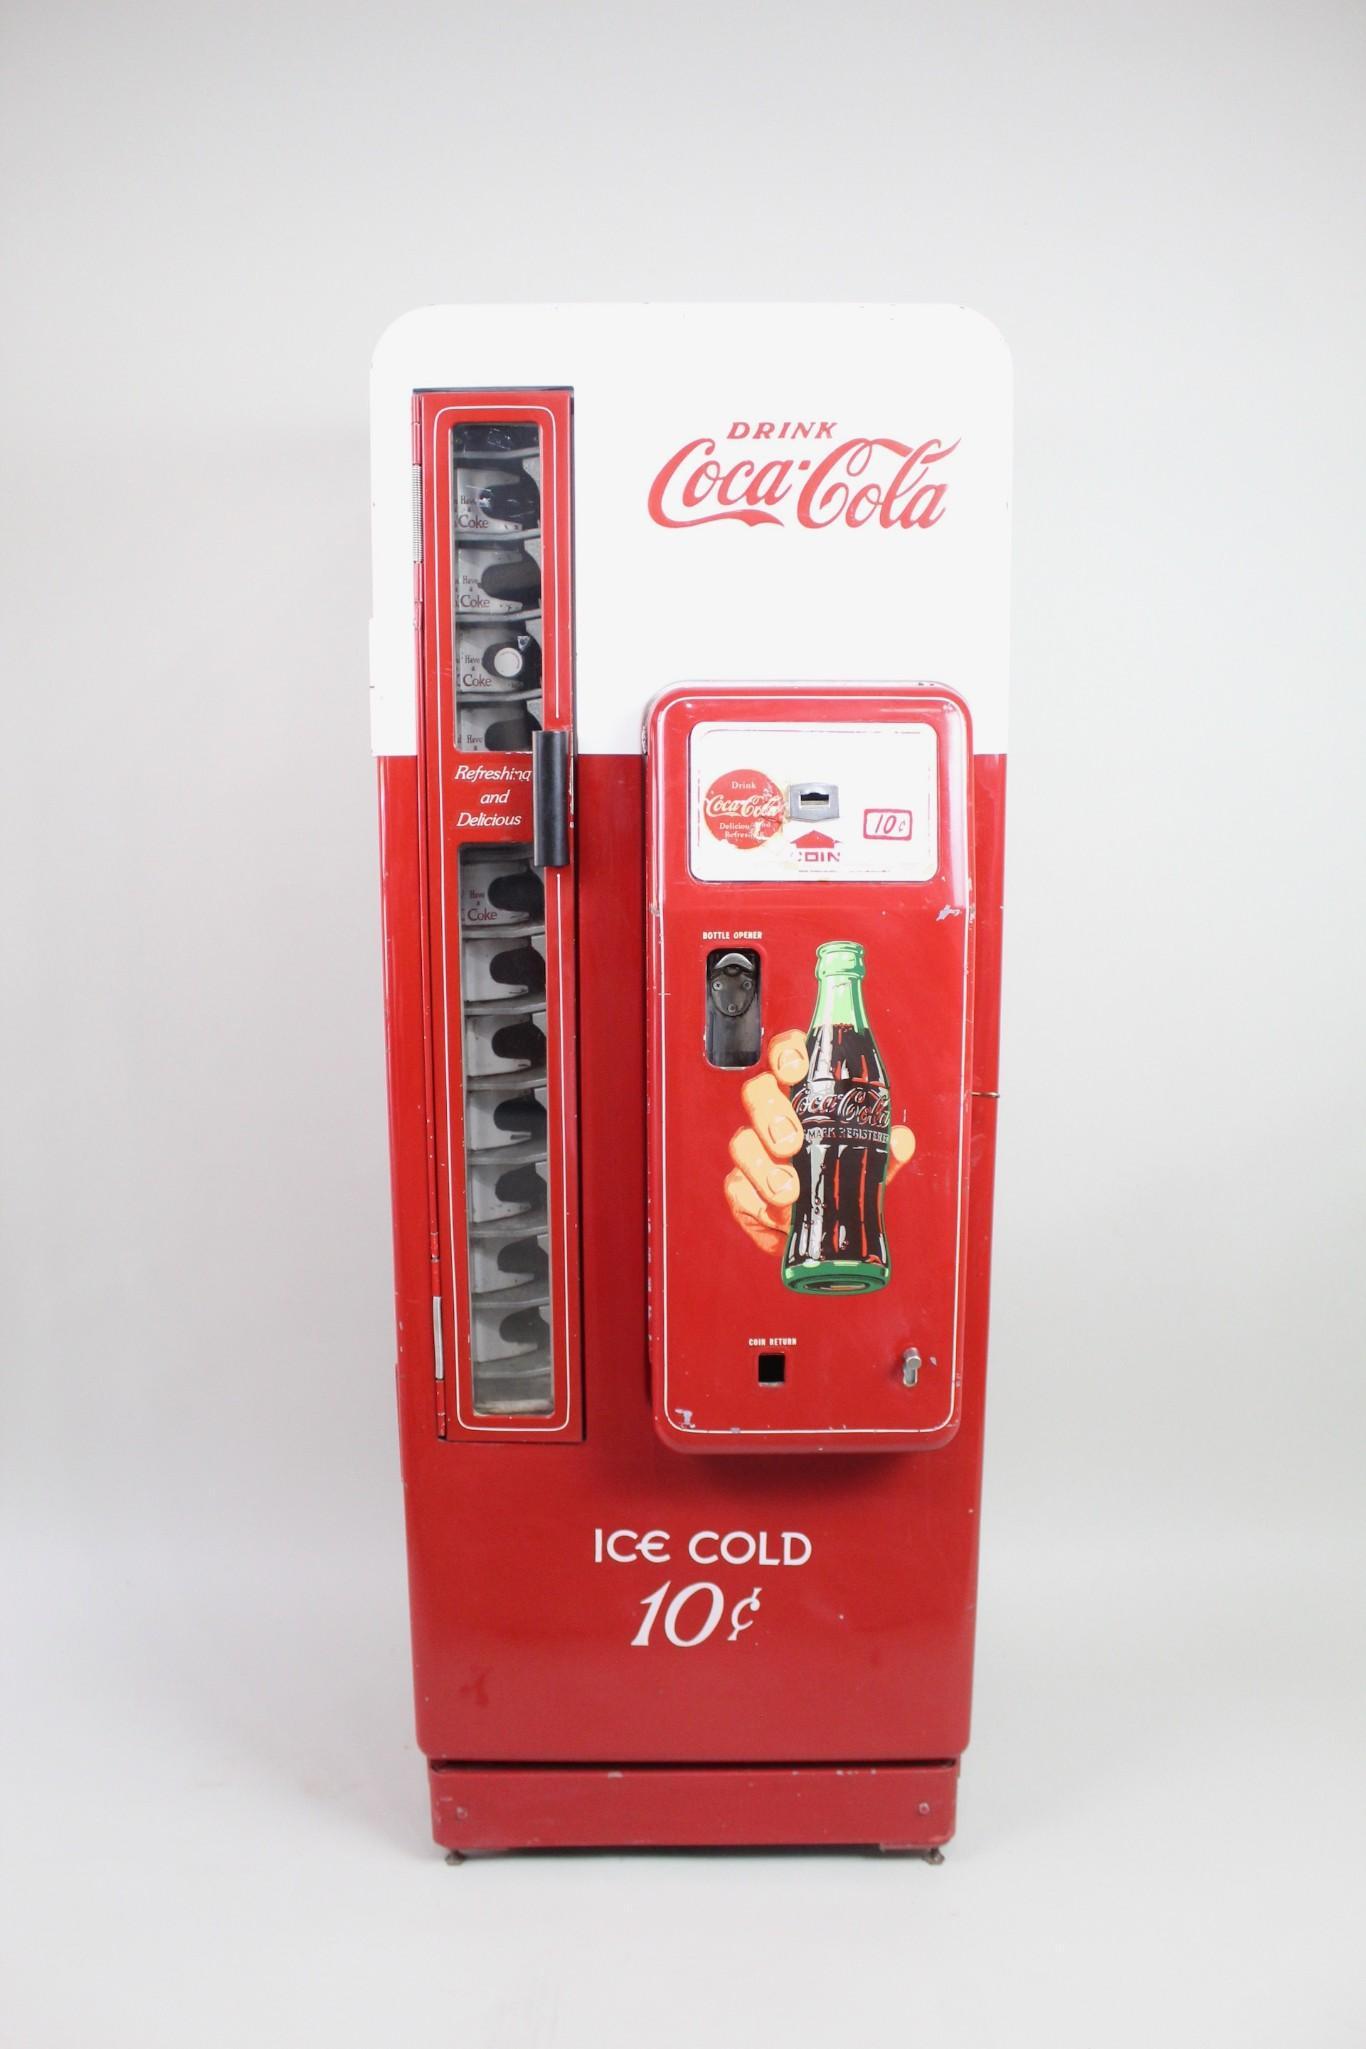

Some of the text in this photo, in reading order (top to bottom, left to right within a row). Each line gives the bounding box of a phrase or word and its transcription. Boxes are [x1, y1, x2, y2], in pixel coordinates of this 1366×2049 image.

[726, 421, 839, 440] DRINK
[647, 437, 962, 530] Coca-Cola
[458, 513, 489, 529] Coke
[460, 594, 490, 609] Coke
[462, 674, 492, 687] Coke
[731, 780, 757, 790] Drink
[480, 789, 511, 804] and
[456, 812, 522, 827] Delicious
[719, 822, 753, 831] Deliciou
[467, 907, 498, 922] Coke
[702, 931, 763, 940] BOTTLE OPENER
[748, 1337, 797, 1346] COIN RETURN
[594, 1528, 813, 1566] ICE COLD
[630, 1580, 763, 1648] 10¢
